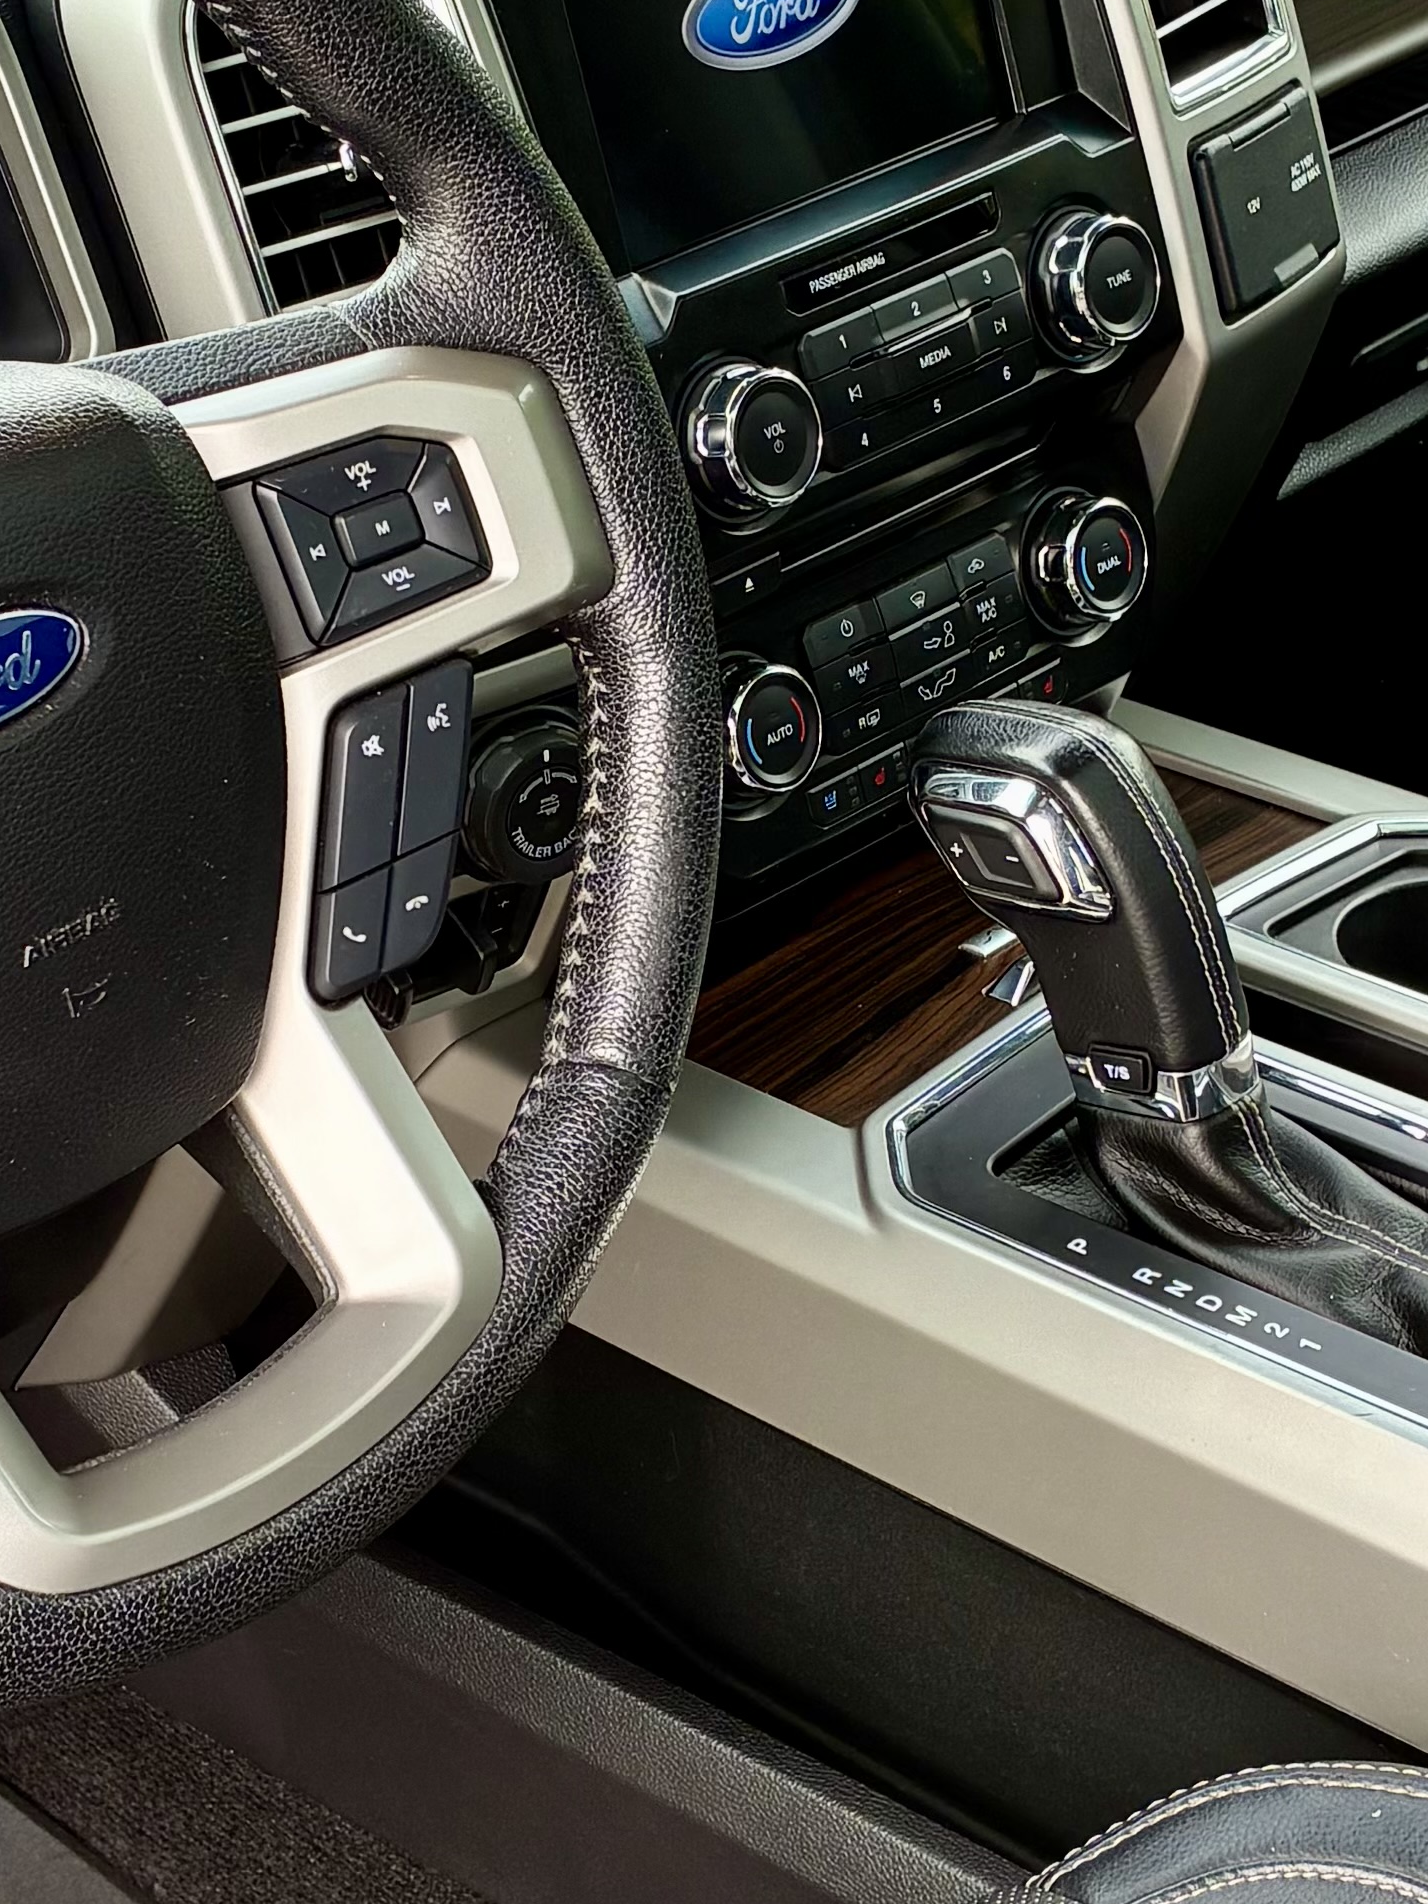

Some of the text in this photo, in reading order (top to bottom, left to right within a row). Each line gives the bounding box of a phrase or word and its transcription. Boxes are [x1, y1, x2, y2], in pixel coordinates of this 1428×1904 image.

[1247, 196, 1261, 214] 12V
[809, 251, 886, 294] PASSENGER AIRBAG
[983, 269, 992, 285] 3
[1106, 269, 1133, 290] TUNE
[910, 301, 921, 317] 2
[838, 334, 847, 349] 1
[919, 345, 952, 369] MEDIA
[1003, 366, 1011, 381] 6
[933, 398, 942, 413] 5
[763, 421, 787, 440] VOL
[861, 432, 869, 446] 4
[344, 460, 377, 481] VOL
[375, 520, 390, 536] M
[1097, 556, 1121, 575] DUAL
[381, 566, 415, 586] VOL
[976, 596, 997, 615] MAX
[981, 608, 998, 623] A/C
[988, 645, 1006, 663] A/C
[848, 660, 870, 678] MAX
[766, 723, 794, 746] AUTO
[512, 826, 579, 858] TRAILER BAC
[1103, 1064, 1130, 1080] T/S
[1067, 1238, 1088, 1255] P
[1132, 1267, 1162, 1285] R
[1164, 1279, 1193, 1298] N
[1195, 1294, 1222, 1312] D
[1225, 1305, 1258, 1327] M
[1264, 1322, 1290, 1339] 2
[1299, 1338, 1322, 1351] 1
